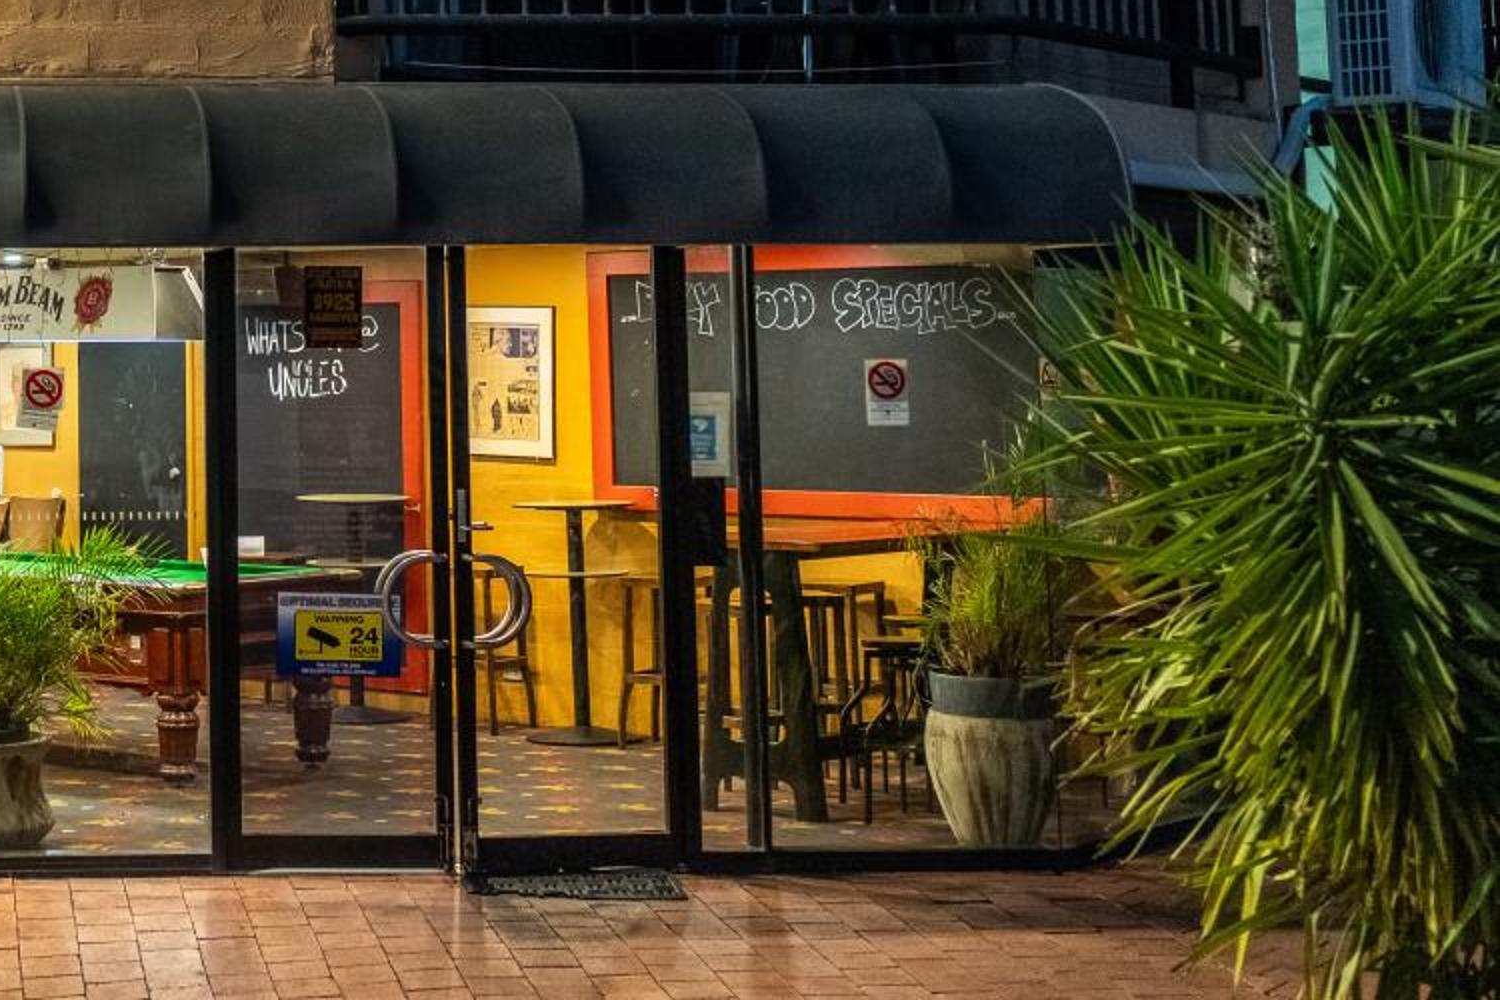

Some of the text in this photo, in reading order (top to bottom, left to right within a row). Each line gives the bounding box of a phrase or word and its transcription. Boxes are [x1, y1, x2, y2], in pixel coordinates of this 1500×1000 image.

[14, 275, 64, 322] BEAM
[754, 282, 816, 331] OOD
[0, 313, 32, 323] SINCE
[245, 317, 307, 355] WHATS
[315, 615, 365, 625] WARNING
[349, 626, 379, 645] 24
[349, 645, 379, 656] HOUR
